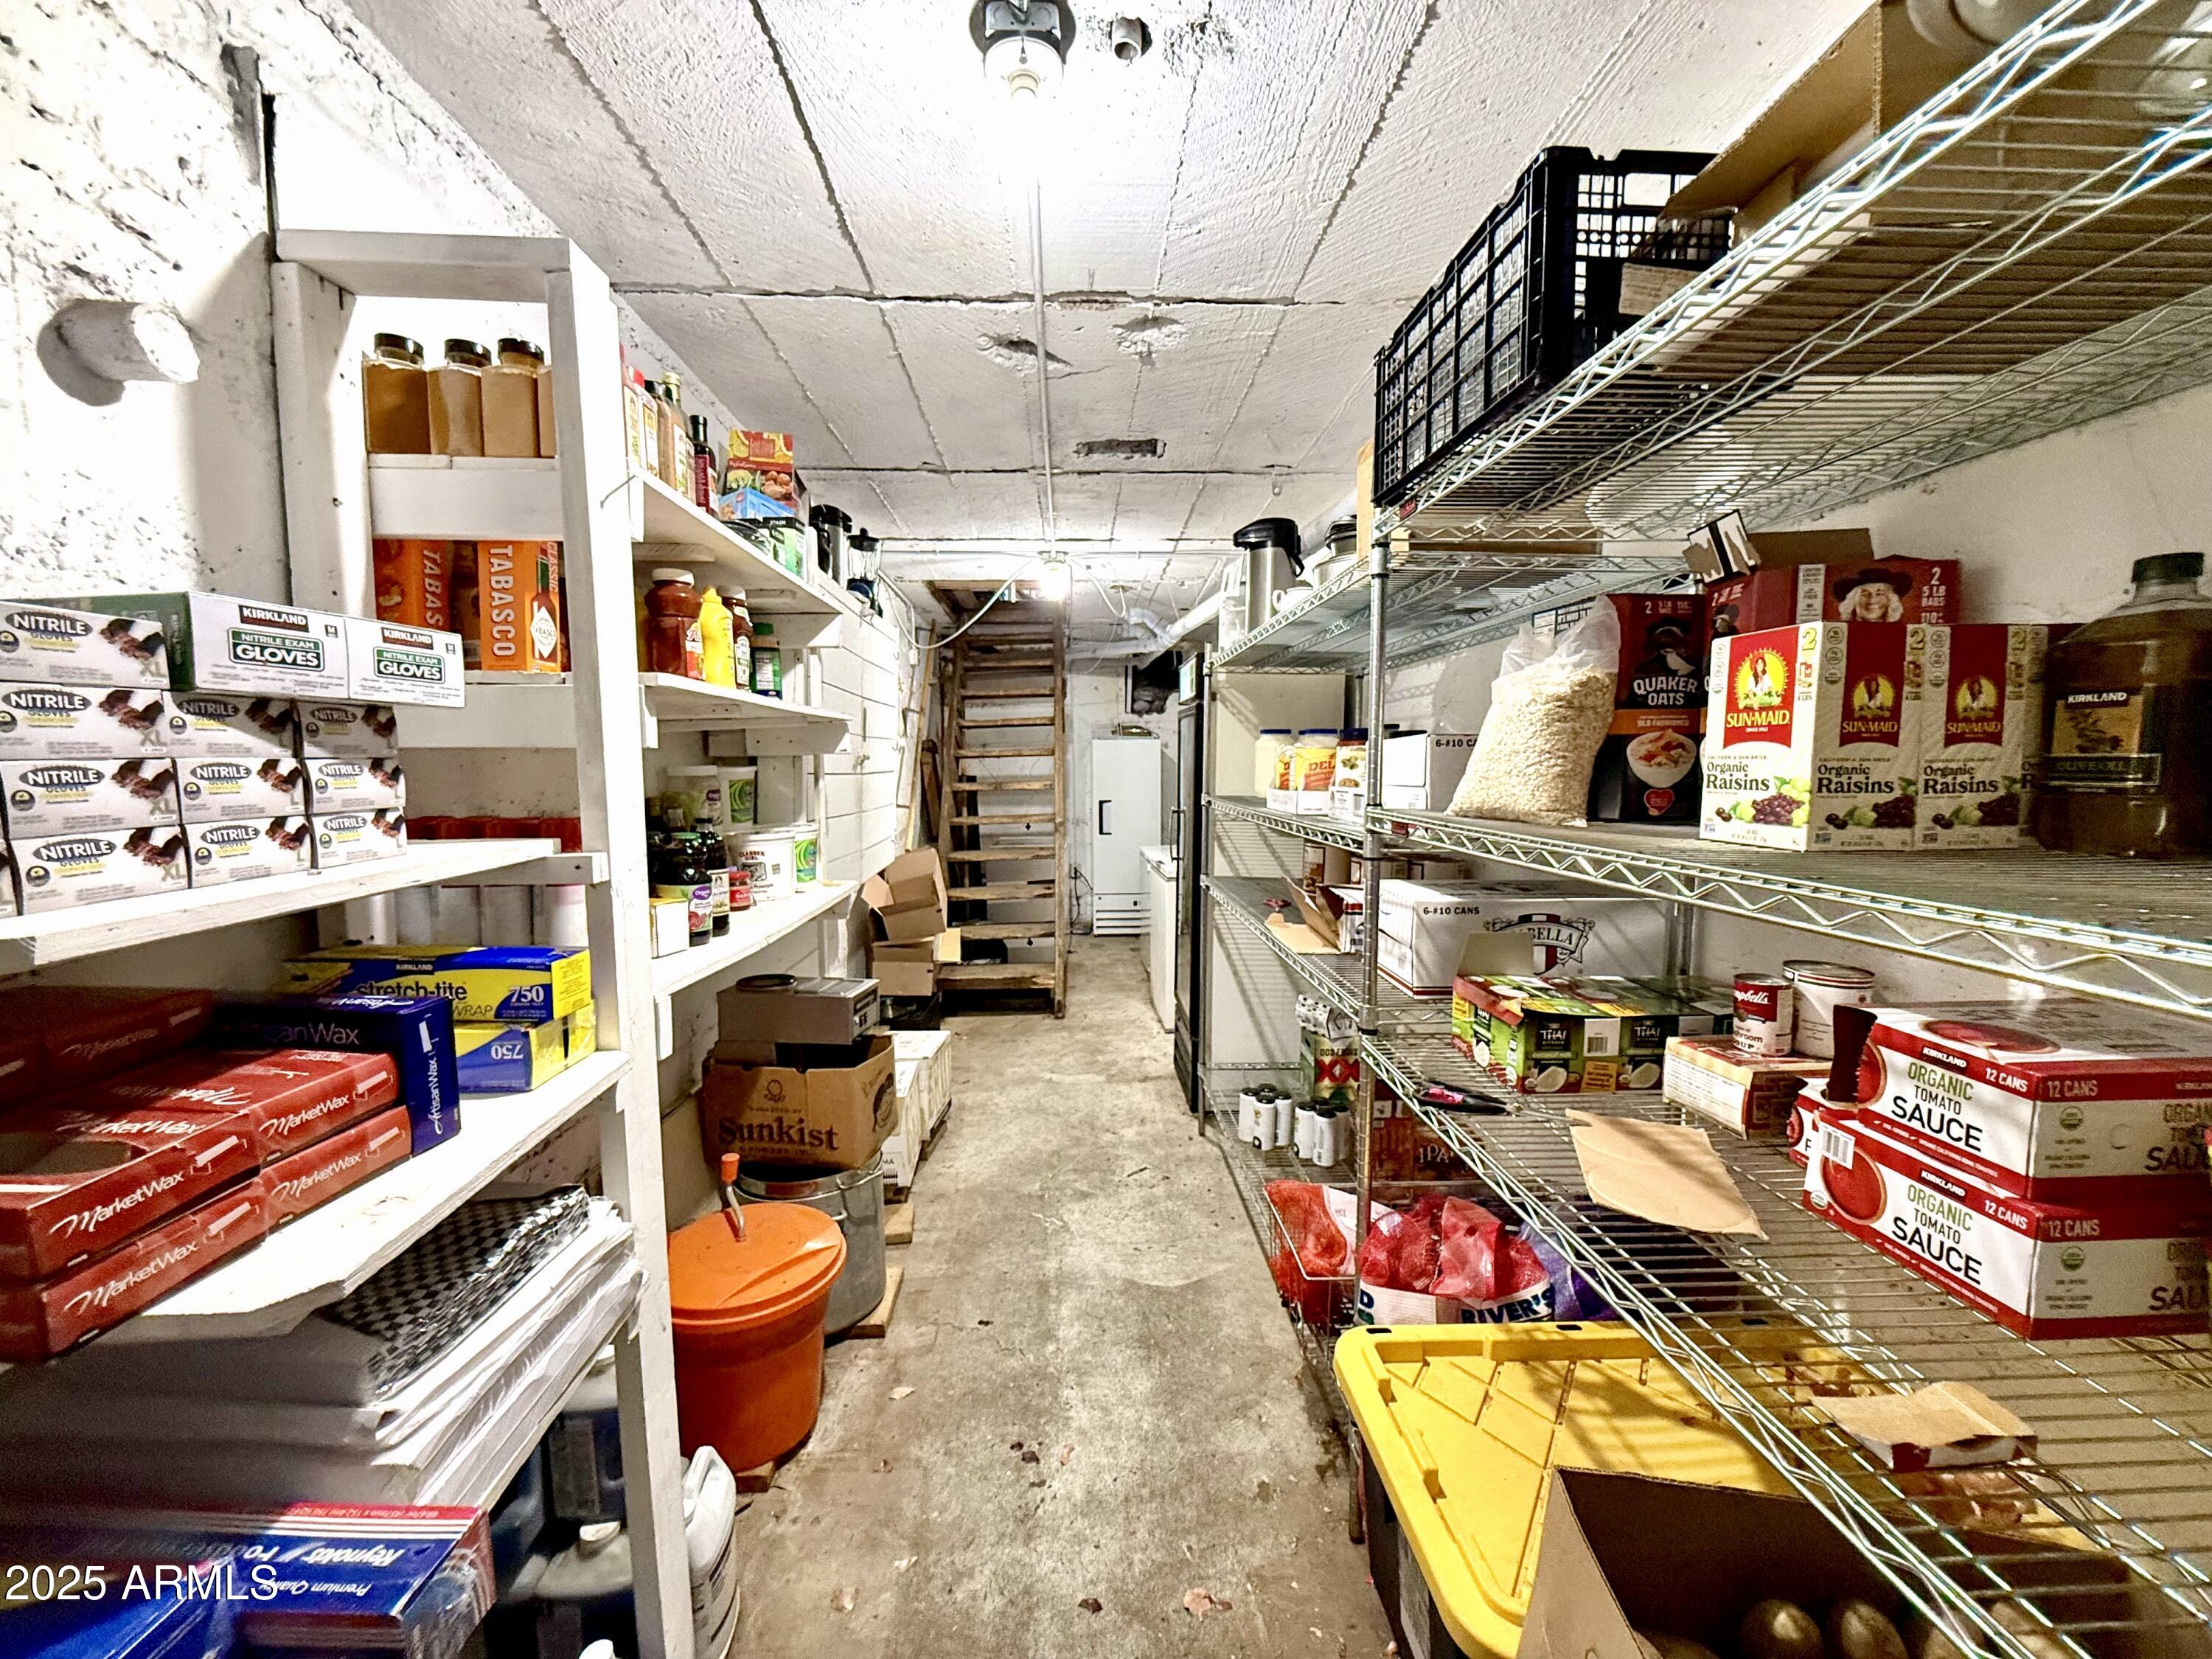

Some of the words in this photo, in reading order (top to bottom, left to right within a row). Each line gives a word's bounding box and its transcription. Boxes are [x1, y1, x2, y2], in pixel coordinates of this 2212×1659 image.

[547, 542, 559, 593] CLASSIC
[1931, 567, 1941, 585] 2
[422, 549, 444, 628] TABAS
[490, 544, 516, 656] TABASCO
[1644, 601, 1652, 613] 2
[13, 614, 87, 635] NITRILE
[242, 608, 307, 626] KIRKLAND
[241, 633, 284, 647] NITRILE
[284, 640, 315, 650] EXAM
[383, 628, 433, 645] KIRKLAND
[1802, 627, 1818, 650] 2
[1910, 627, 1925, 650] 2
[235, 644, 319, 667] GLOVES
[383, 651, 414, 662] NITRILE
[415, 656, 438, 664] EXAM
[378, 661, 442, 681] GLOVES
[1633, 675, 1697, 695] QUAKER
[10, 693, 85, 709] NITRILE
[1647, 693, 1685, 706] OATS
[2067, 692, 2128, 704] KIRKLAND
[183, 701, 236, 715] NITRILE
[314, 709, 355, 723] NITRILE
[27, 769, 100, 785] NITRILE
[196, 766, 249, 779] NITRILE
[320, 764, 362, 776] NITRILE
[1707, 762, 1749, 774] Organic
[1818, 764, 1871, 778] Organic
[1924, 765, 1975, 779] Organic
[1705, 774, 1770, 791] Raisins
[1816, 776, 1894, 794] Raisins
[1922, 777, 1999, 795] Raisins
[326, 817, 367, 830] NITRILE
[206, 827, 257, 843] NITRILE
[39, 841, 111, 860] NITRILE
[1422, 906, 1451, 916] 6-#10
[1453, 906, 1480, 916] CANS
[396, 963, 434, 971] KIRKLAND
[356, 981, 468, 1001] stretch-tite
[510, 985, 545, 1004] 750
[451, 1006, 493, 1018] WRAP
[1540, 1029, 1567, 1040] THAI
[1634, 1026, 1660, 1037] THAI
[490, 1044, 524, 1061] 750
[1923, 1047, 1967, 1068] KIRKLAND
[1907, 1061, 1974, 1101] ORGANIC
[1985, 1067, 1997, 1082] 12
[1998, 1072, 2028, 1093] CANS
[2048, 1080, 2062, 1098] 12
[2065, 1079, 2098, 1097] CANS
[428, 1057, 442, 1135] ArtisanWax
[1914, 1084, 1962, 1116] TOMATO
[258, 1093, 350, 1138] MarketWax
[1891, 1095, 1983, 1152] SAUCE
[718, 1116, 839, 1151] Sunkist
[1419, 1144, 1449, 1164] IPA
[271, 1152, 362, 1201] MarketWax
[1921, 1170, 1966, 1197] KIRKLAND
[49, 1169, 185, 1239] MarketWax
[1907, 1183, 1973, 1232] ORGANIC
[1984, 1200, 1997, 1215] 12
[1997, 1207, 2028, 1230] CANS
[1914, 1208, 1961, 1245] TOMATO
[2048, 1220, 2062, 1237] 12
[2065, 1219, 2101, 1237] CANS
[1891, 1216, 1983, 1285] SAUCE
[63, 1240, 199, 1316] MarketWax
[1461, 1287, 1554, 1324] RIVER'S
[301, 1543, 406, 1568] Reynolds
[310, 1582, 372, 1597] Premium
